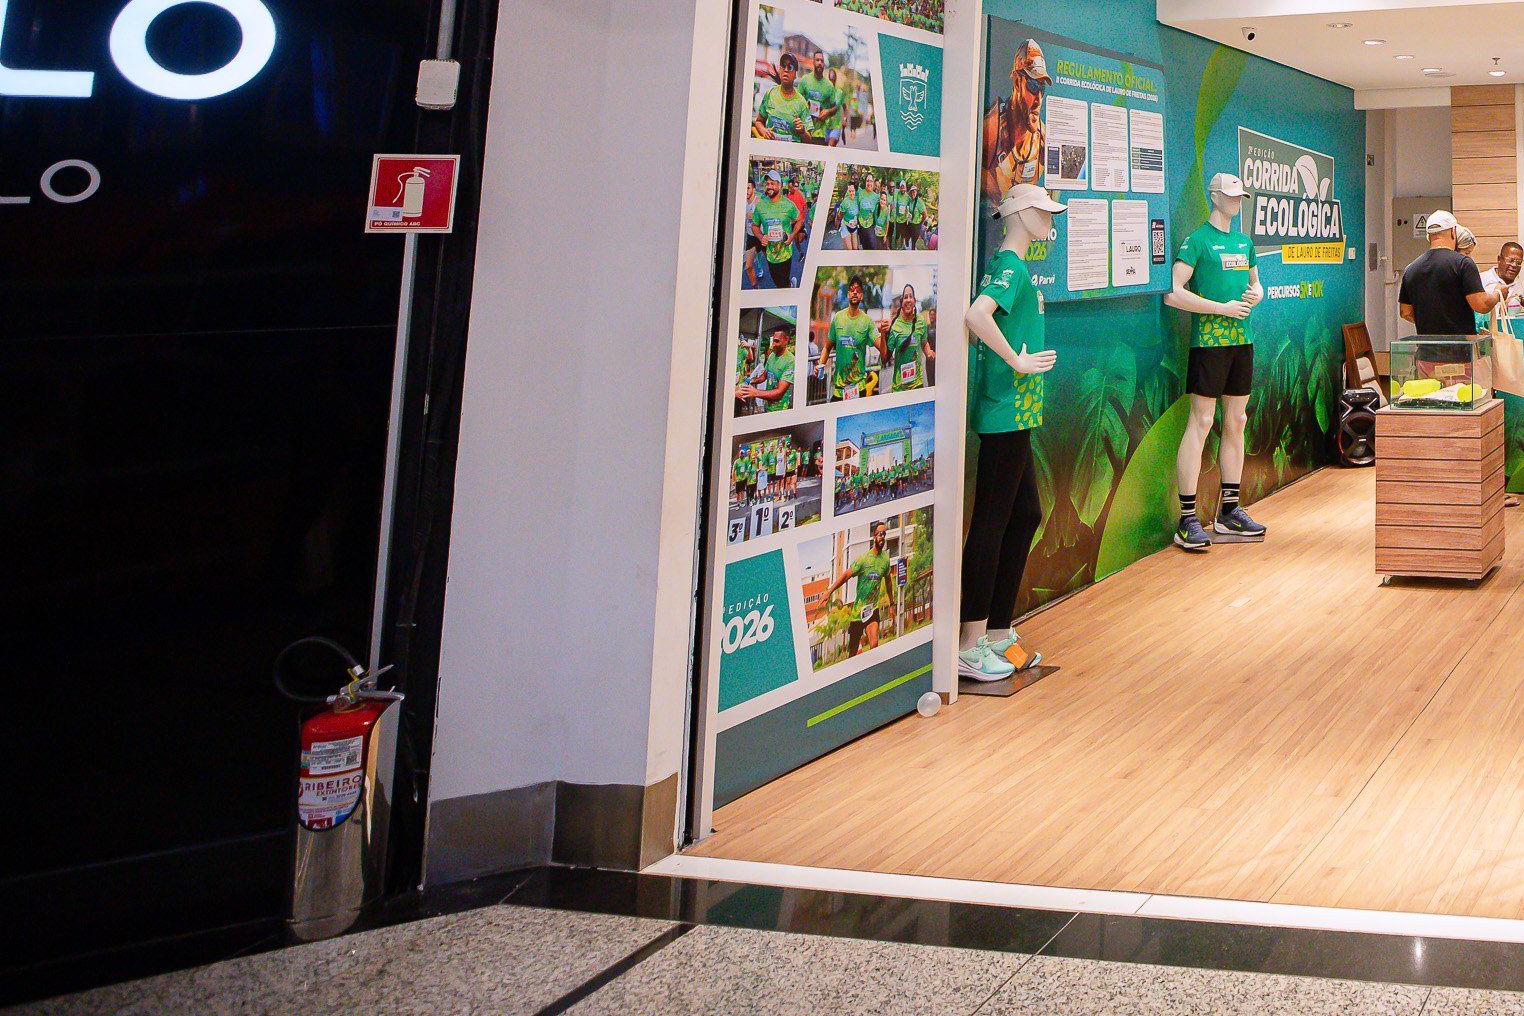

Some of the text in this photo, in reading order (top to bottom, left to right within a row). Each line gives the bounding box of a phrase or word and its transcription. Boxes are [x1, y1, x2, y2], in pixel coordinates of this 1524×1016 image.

[1056, 59, 1158, 93] REGULAMENTO OFICIAL:
[1253, 146, 1275, 160] EDIÇÃO
[1243, 157, 1299, 194] CORRIDA
[1254, 191, 1340, 239] ECOLÓGICA
[1025, 241, 1047, 261] 026
[1287, 246, 1341, 258] DE LAURO DE FREITAS
[1038, 274, 1056, 285] Parvi
[1267, 284, 1300, 300] PERCURSOS
[728, 593, 769, 615] EDIÇÃO
[720, 603, 775, 655] 026
[305, 774, 362, 791] RIBEIRO
